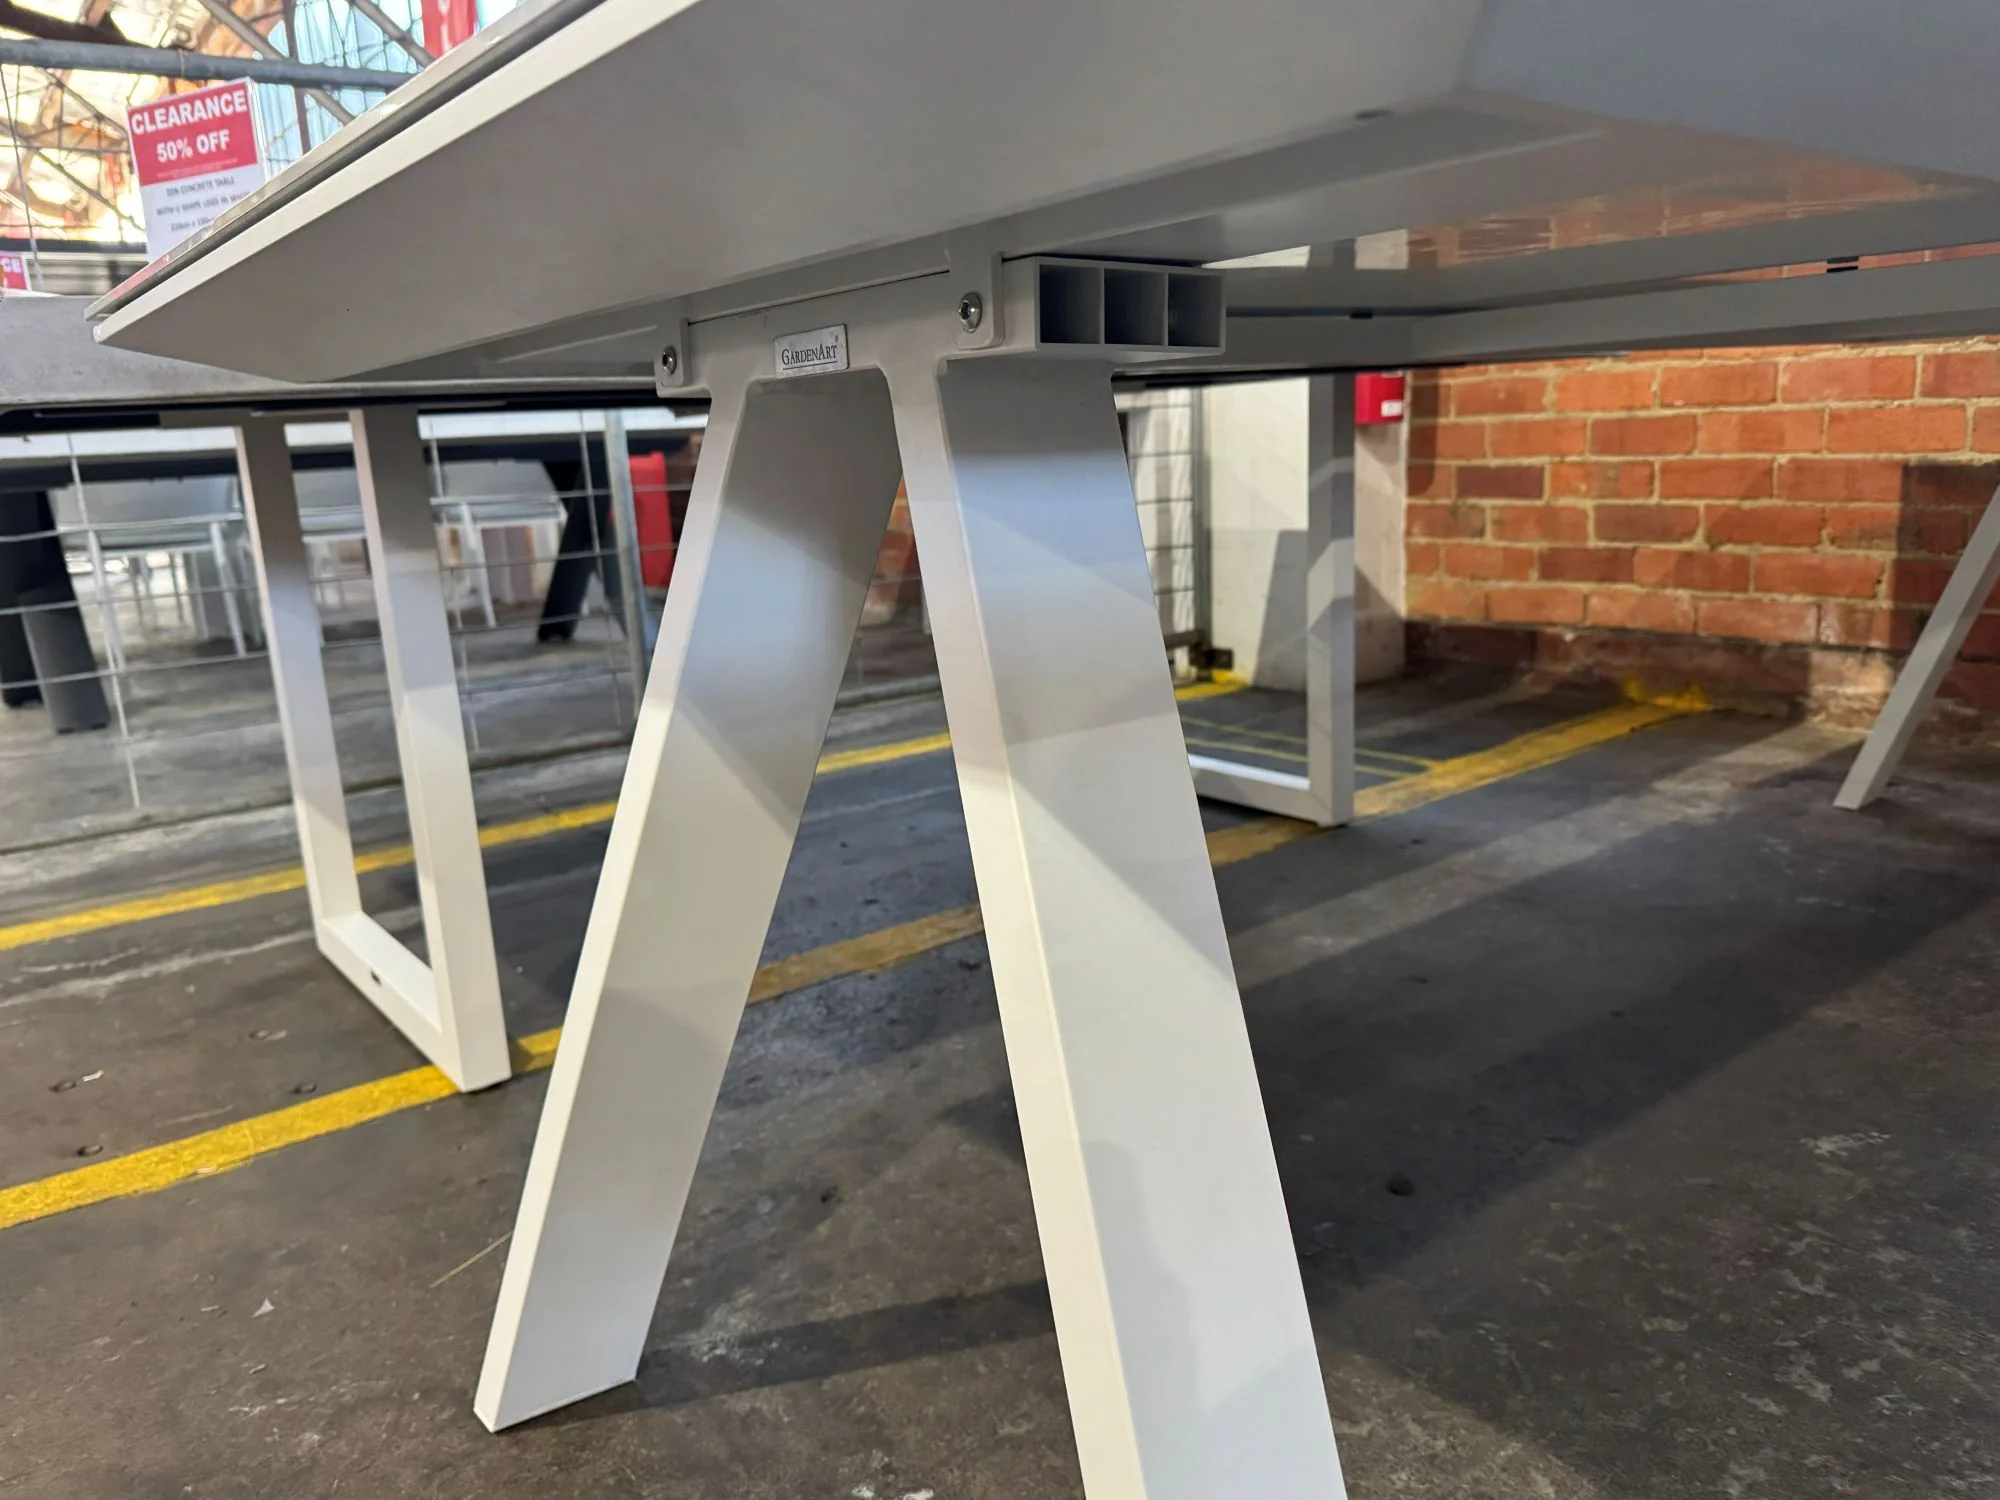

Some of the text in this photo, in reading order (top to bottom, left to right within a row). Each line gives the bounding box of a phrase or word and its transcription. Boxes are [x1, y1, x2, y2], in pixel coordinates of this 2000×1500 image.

[131, 90, 247, 135] CLEARANCE
[157, 129, 230, 163] 50% OFF
[180, 180, 214, 195] CONCRETE
[215, 176, 235, 188] TABLE
